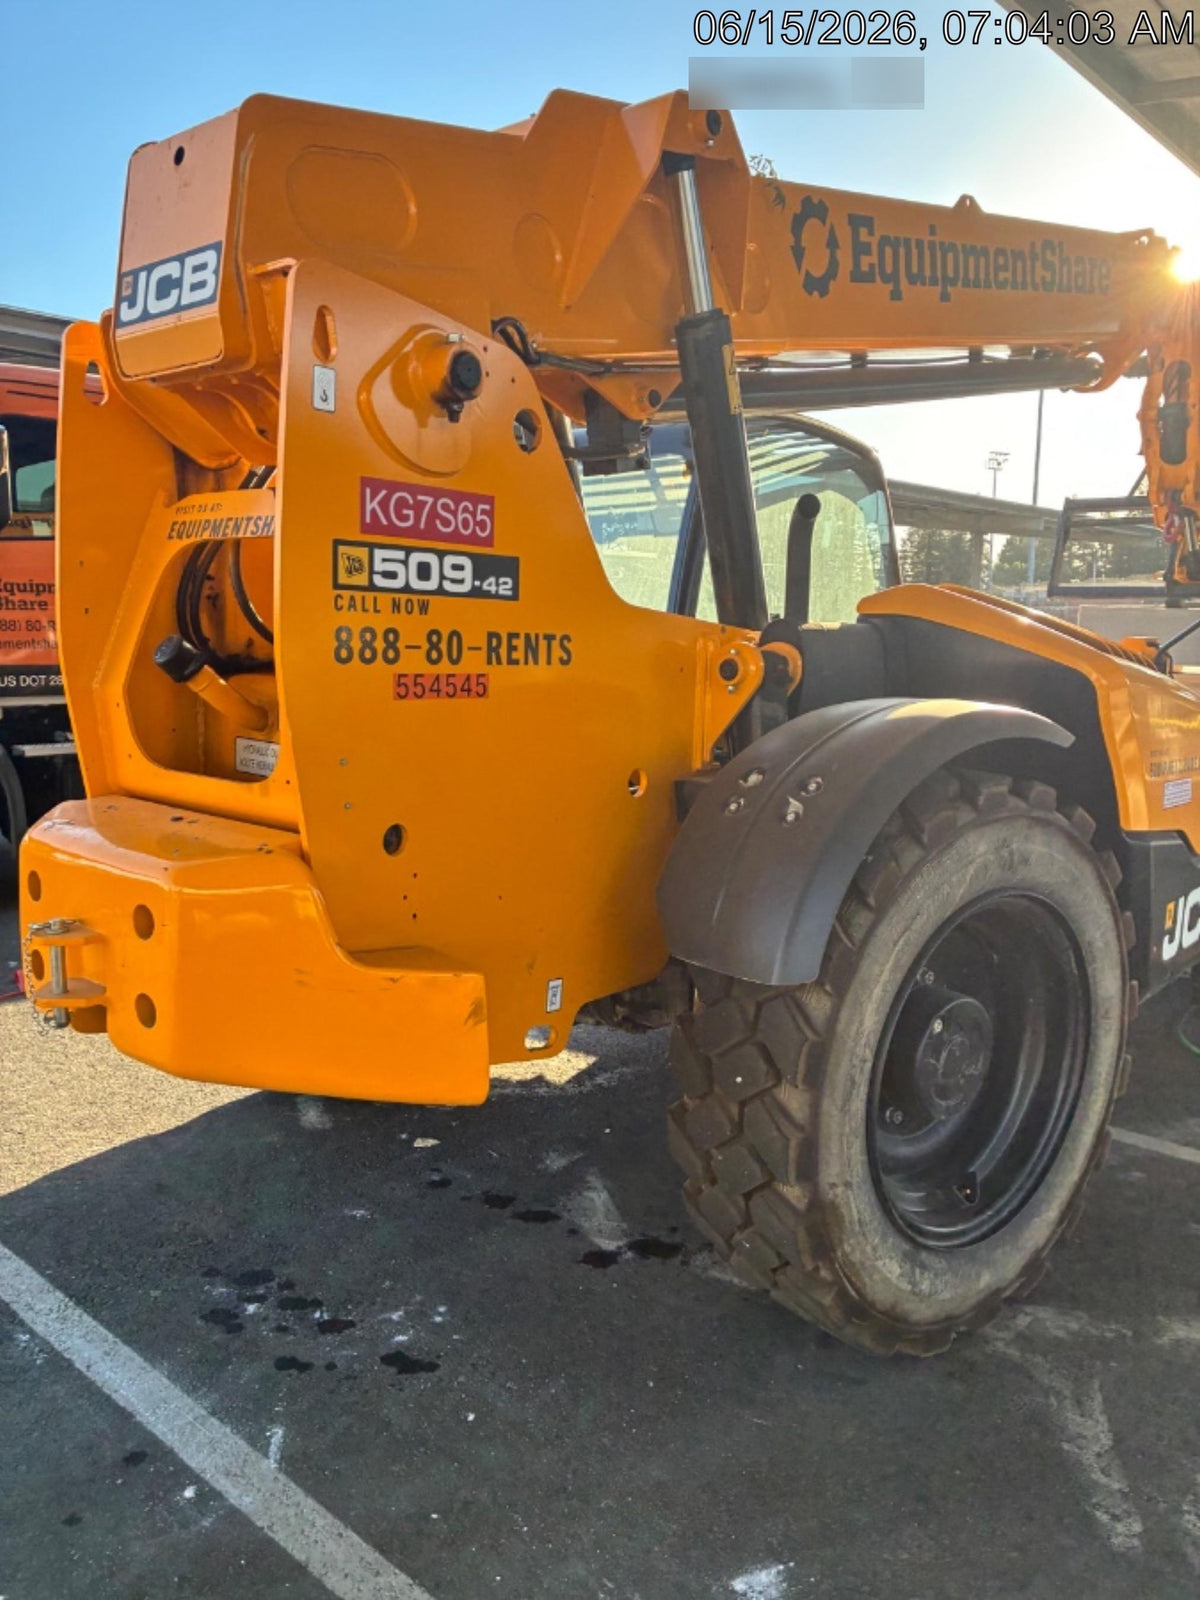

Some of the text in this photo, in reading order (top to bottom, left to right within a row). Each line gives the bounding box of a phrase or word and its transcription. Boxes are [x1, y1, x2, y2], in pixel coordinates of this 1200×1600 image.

[848, 213, 1111, 302] EquipmentShare
[120, 249, 218, 322] JCB
[167, 515, 276, 539] EQUIPMENTSH
[364, 487, 492, 537] KG7S65
[333, 594, 430, 615] CALL NOW
[333, 624, 573, 666] 888-80-RENTS
[19, 675, 47, 687] DOT
[395, 674, 488, 699] 554545
